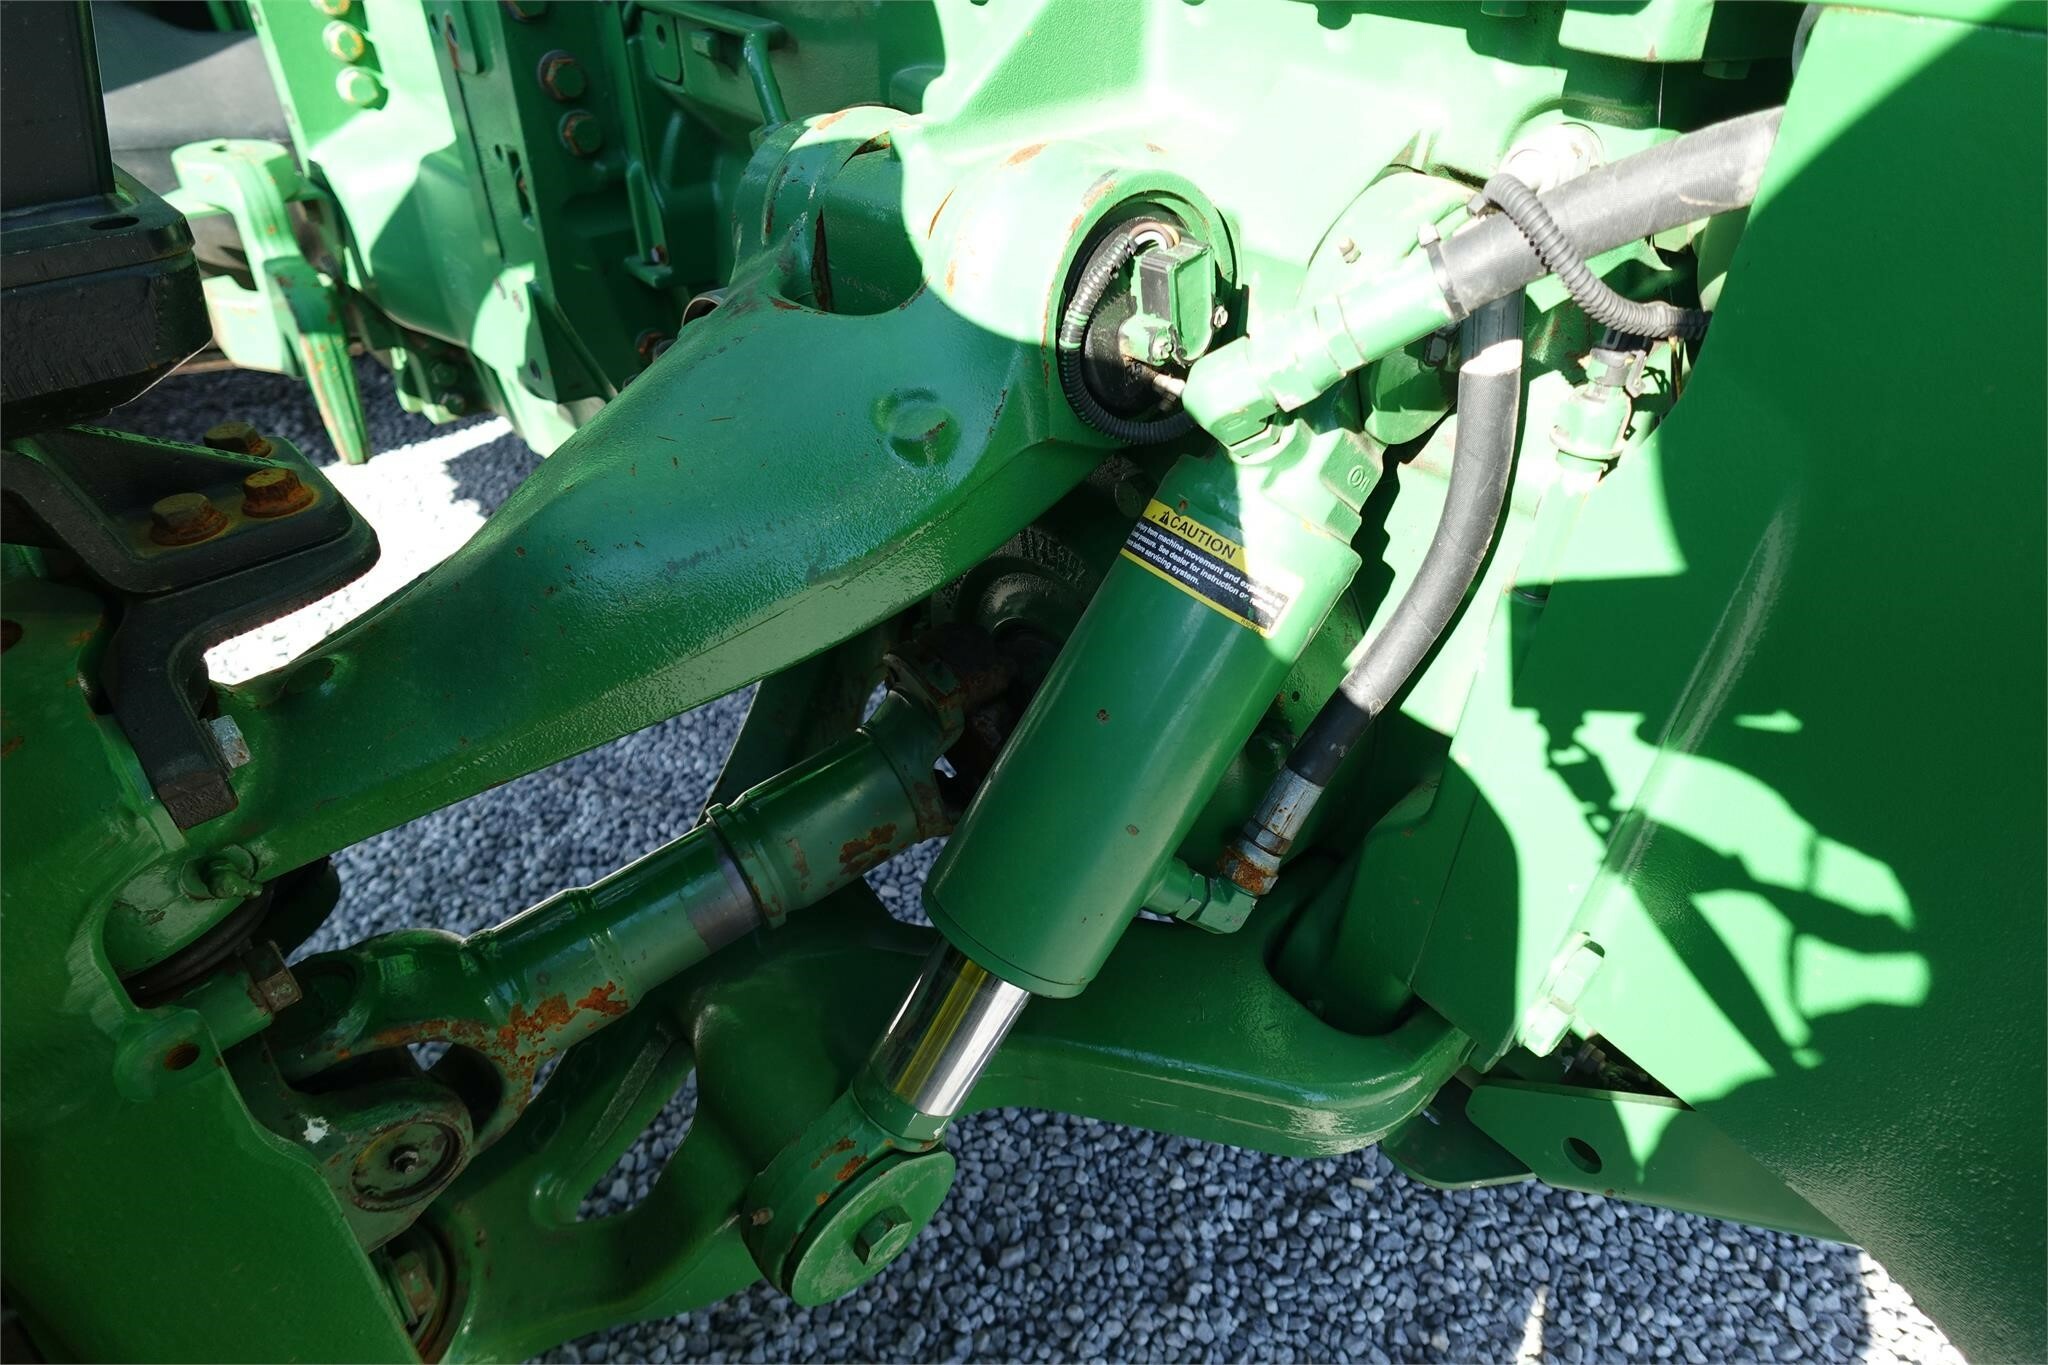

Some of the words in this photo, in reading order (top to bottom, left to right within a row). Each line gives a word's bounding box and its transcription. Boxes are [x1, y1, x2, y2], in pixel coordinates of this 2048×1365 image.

[1157, 534, 1184, 552] machine
[1184, 549, 1224, 575] movement
[1223, 571, 1241, 584] and
[1170, 516, 1236, 560] CAUTION
[1144, 549, 1172, 570] servicing
[1171, 565, 1199, 585] system.
[1158, 544, 1170, 556] See
[1169, 552, 1190, 567] dealer
[1189, 562, 1201, 573] for
[1200, 568, 1240, 595] instruction
